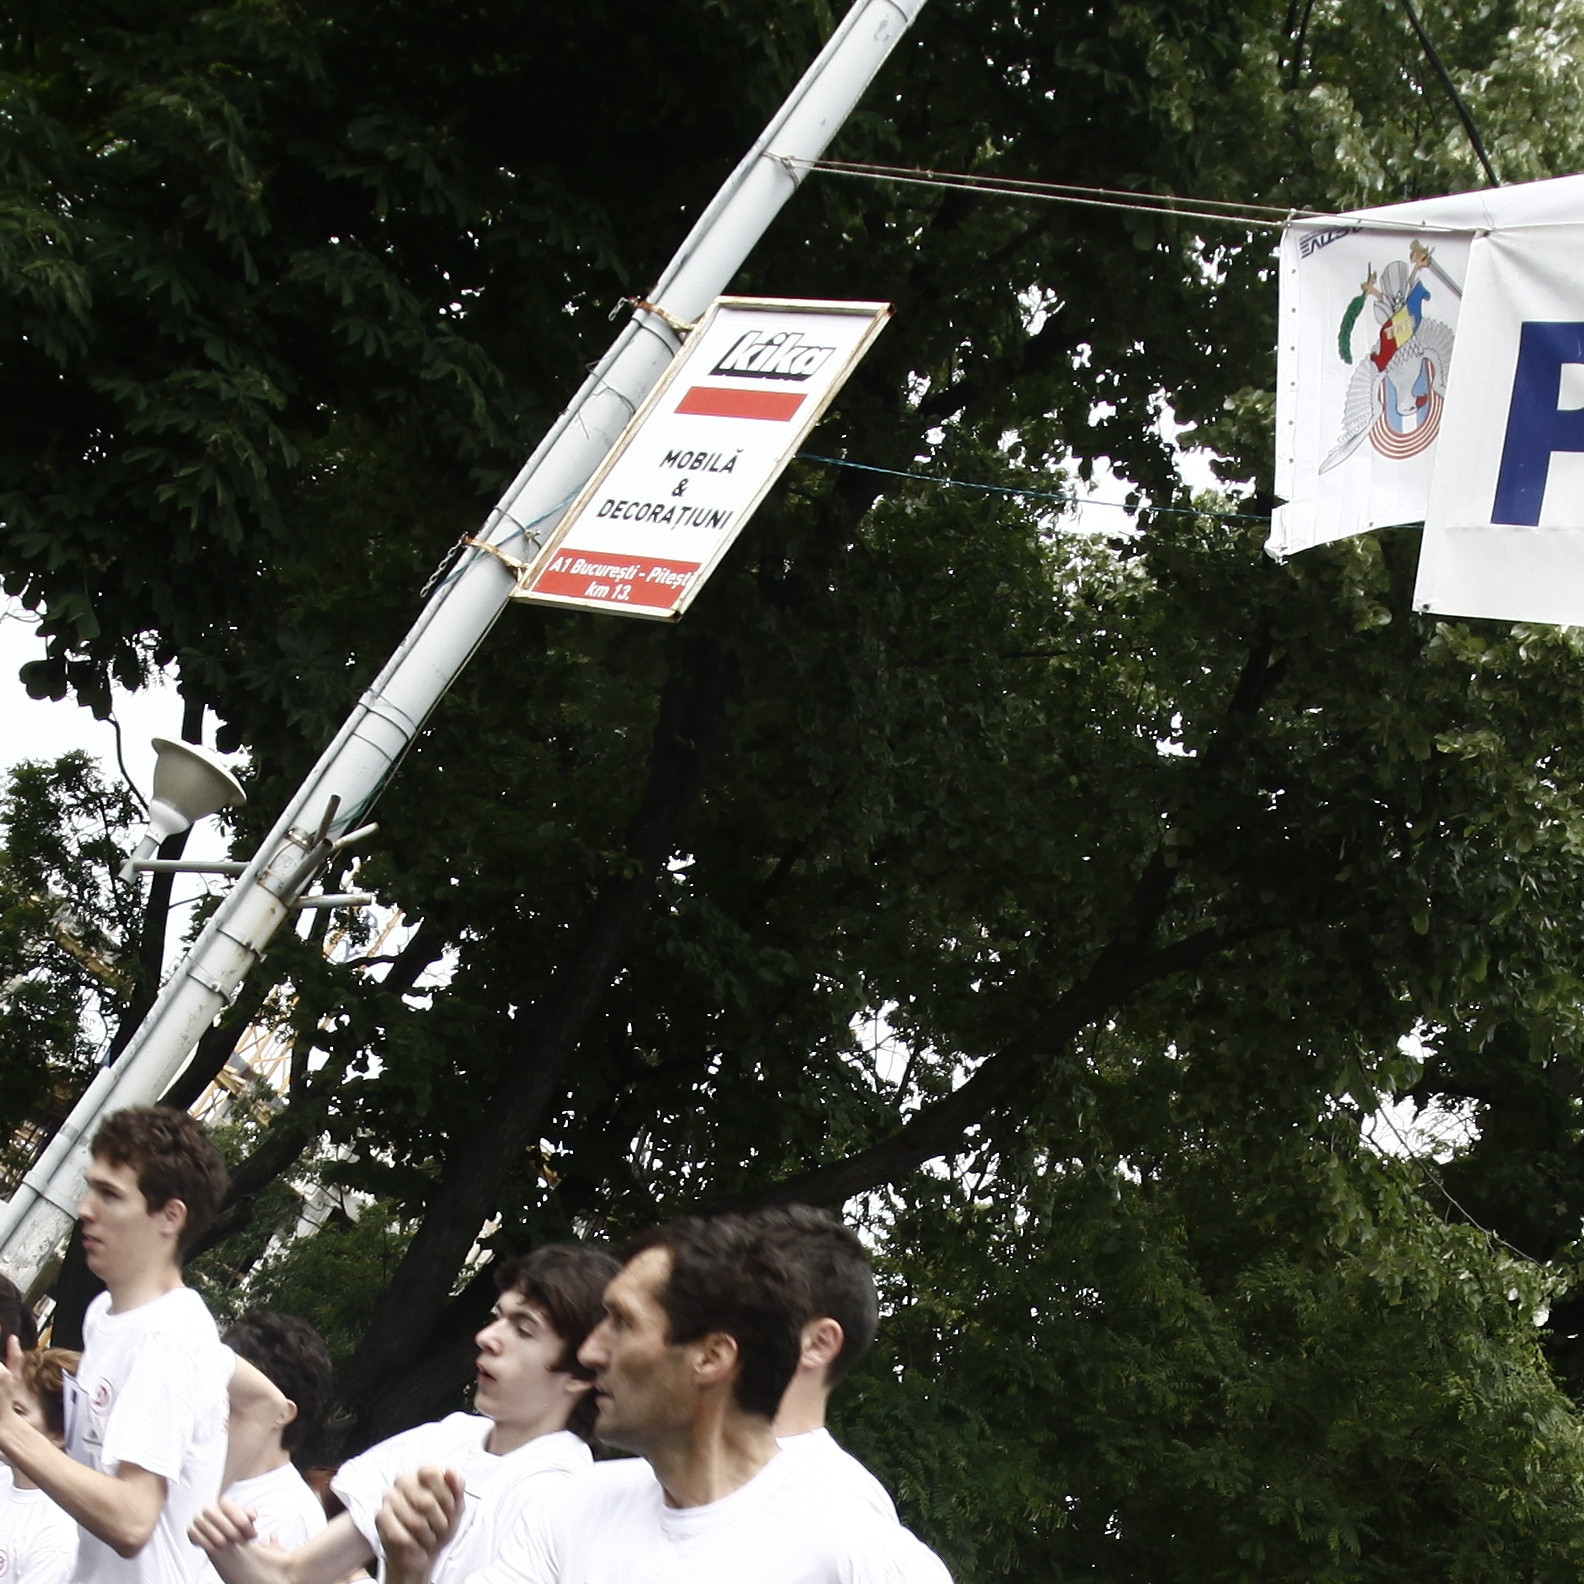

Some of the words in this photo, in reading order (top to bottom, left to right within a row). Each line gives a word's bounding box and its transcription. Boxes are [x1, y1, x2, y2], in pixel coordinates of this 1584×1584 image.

[707, 330, 837, 381] kika
[659, 449, 743, 474] MOBILĂ
[671, 478, 689, 497] &
[596, 499, 734, 530] DECORAȚIUNI
[548, 556, 573, 573] A1
[584, 580, 611, 599] km
[610, 584, 633, 601] 13.
